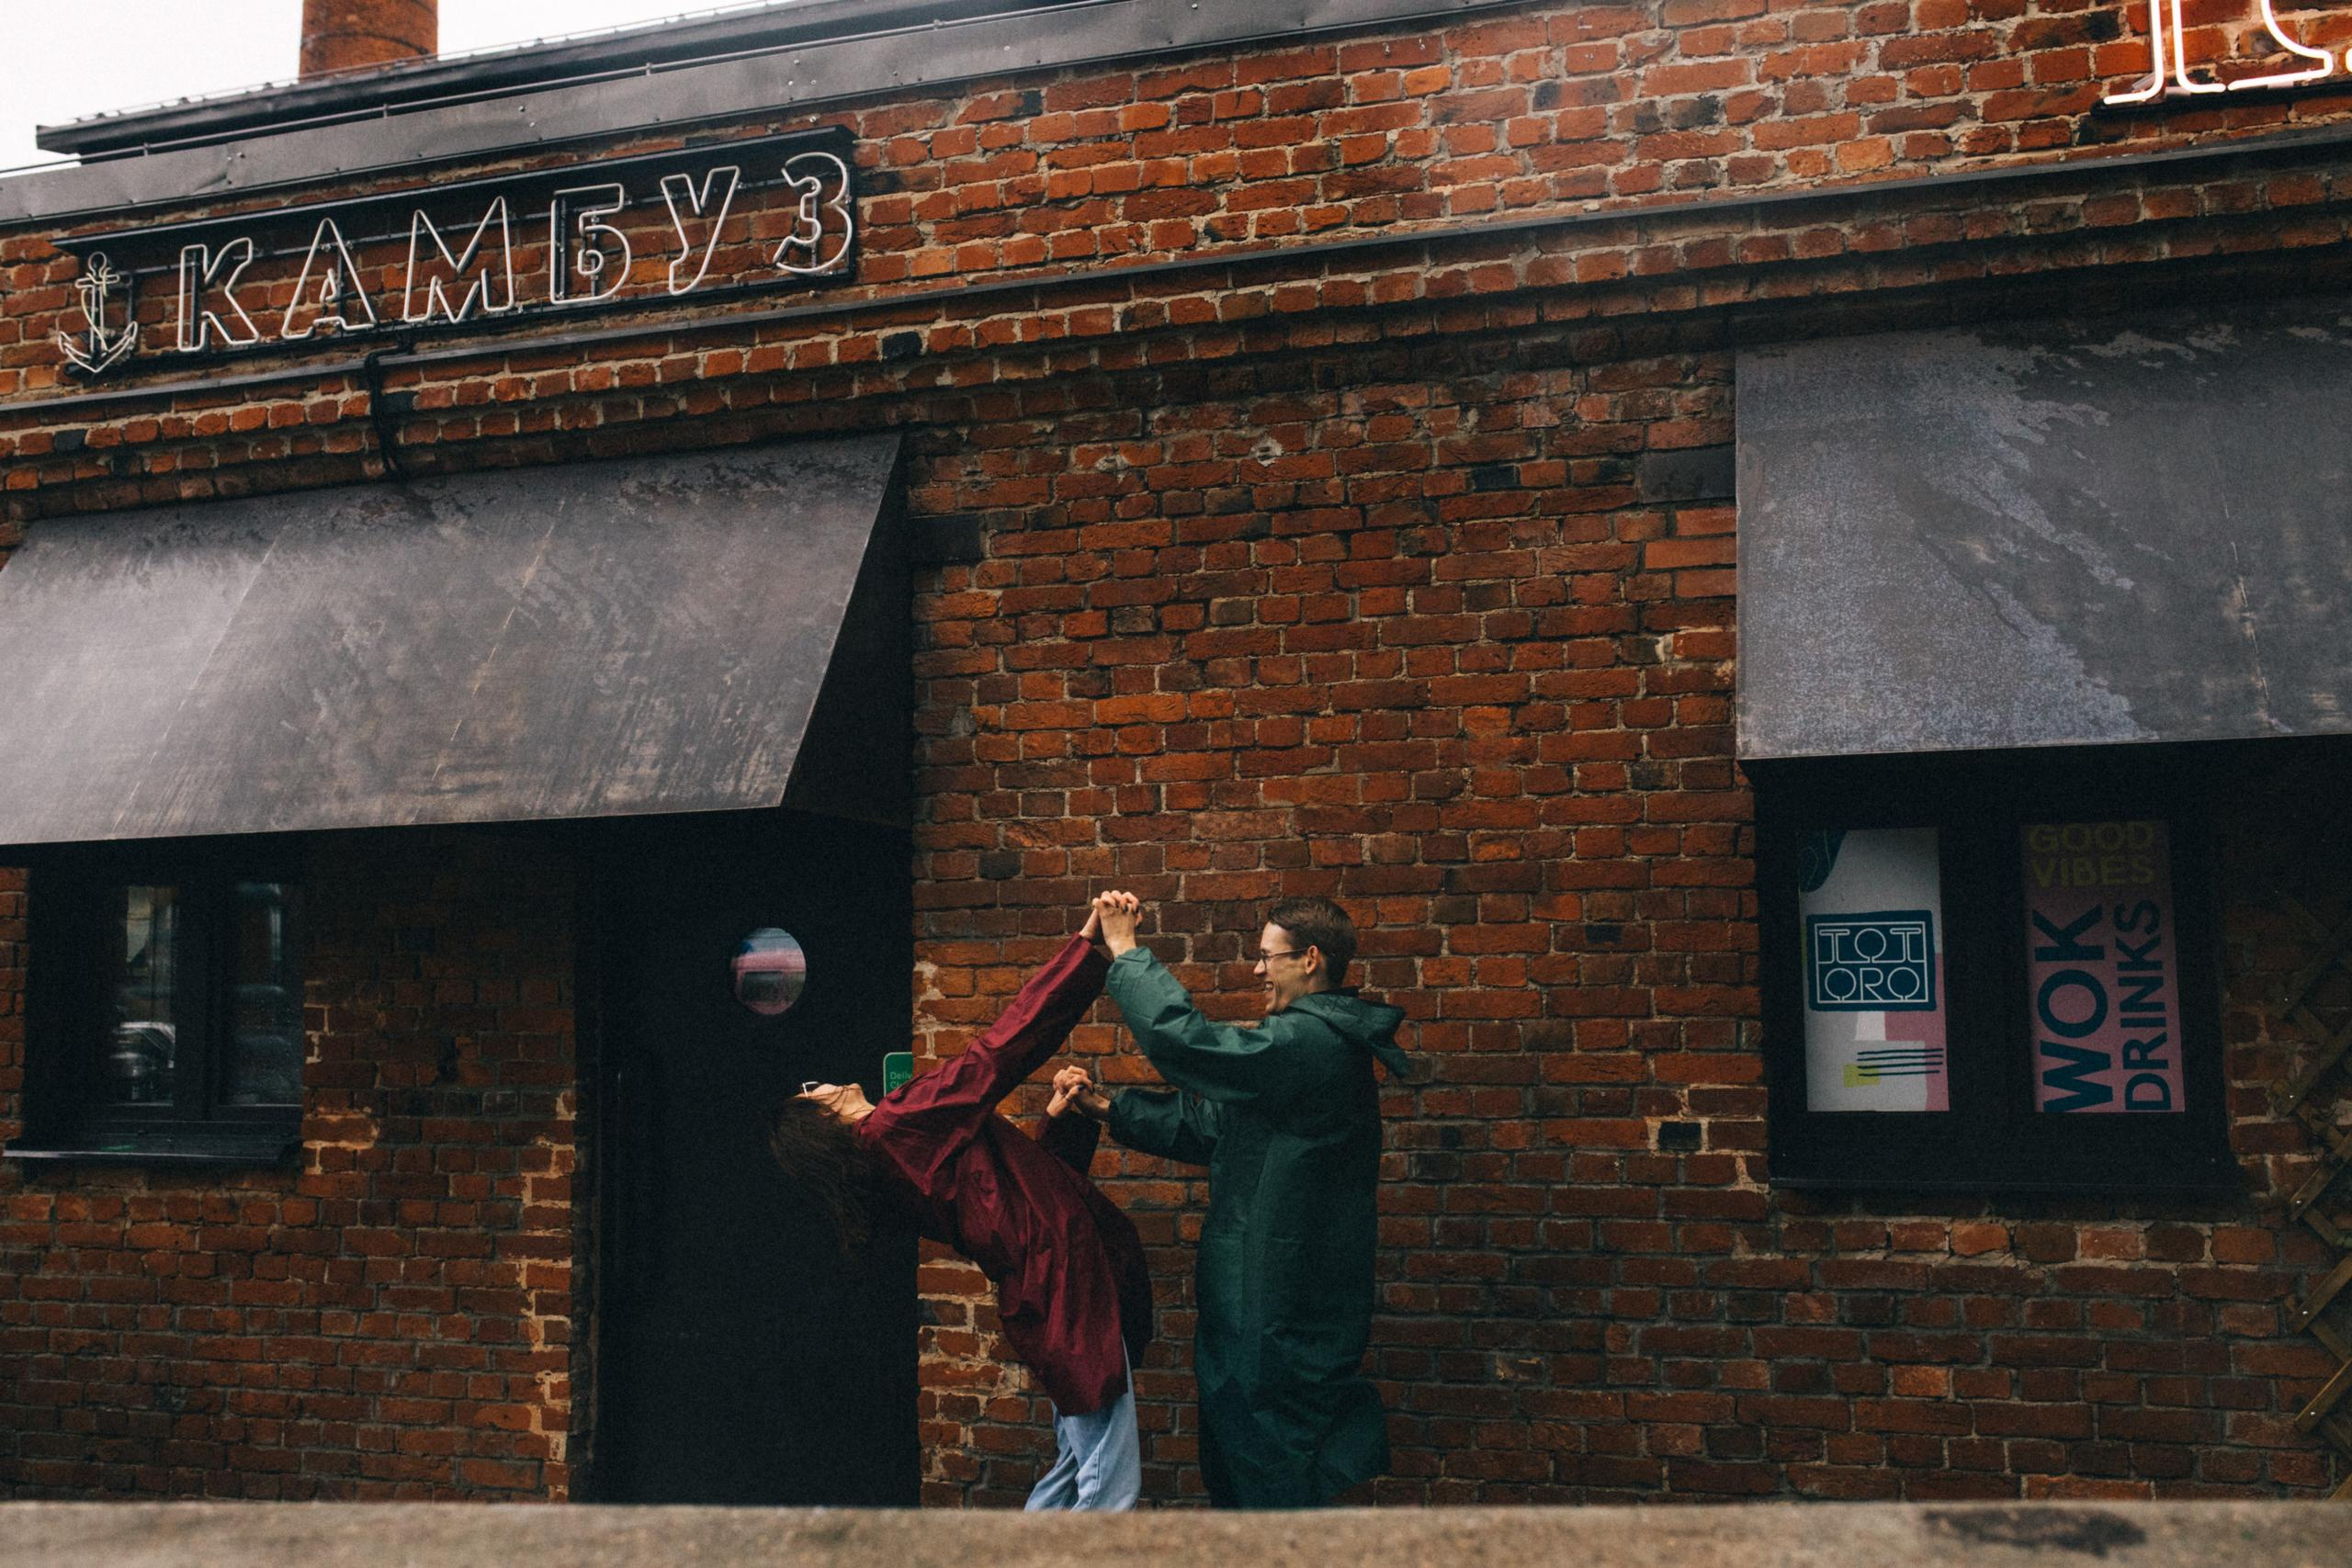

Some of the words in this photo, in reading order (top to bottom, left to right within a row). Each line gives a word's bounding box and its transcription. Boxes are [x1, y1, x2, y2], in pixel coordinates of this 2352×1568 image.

[2028, 821, 2154, 853] GOOD
[2031, 855, 2154, 888] VIBES
[1824, 966, 1921, 1003] ORO
[2032, 904, 2114, 1113] WOK
[2115, 898, 2173, 1111] DRINKS
[889, 1070, 912, 1080] Deliv
